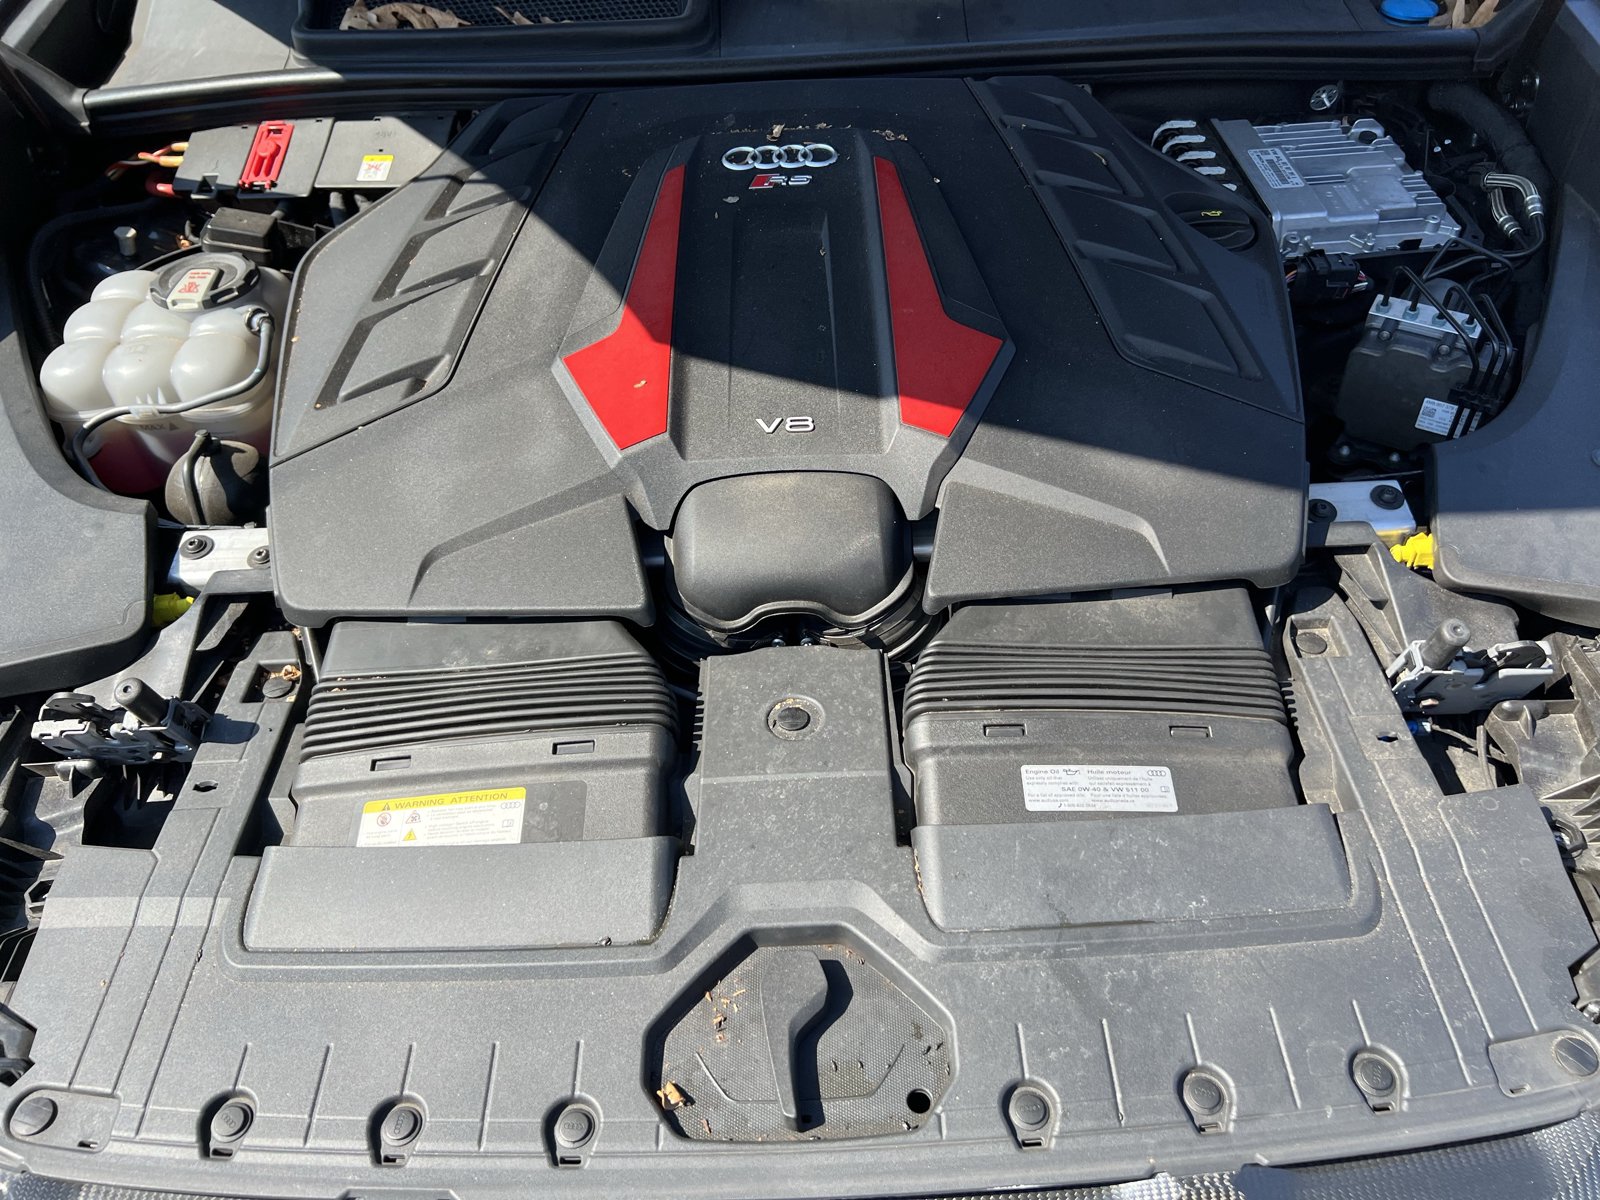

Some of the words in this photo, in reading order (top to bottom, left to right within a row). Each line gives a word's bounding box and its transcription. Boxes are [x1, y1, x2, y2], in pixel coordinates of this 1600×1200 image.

[757, 174, 812, 187] RS
[755, 416, 815, 434] V8
[395, 798, 445, 809] WARNING
[449, 793, 508, 804] ATTENTION
